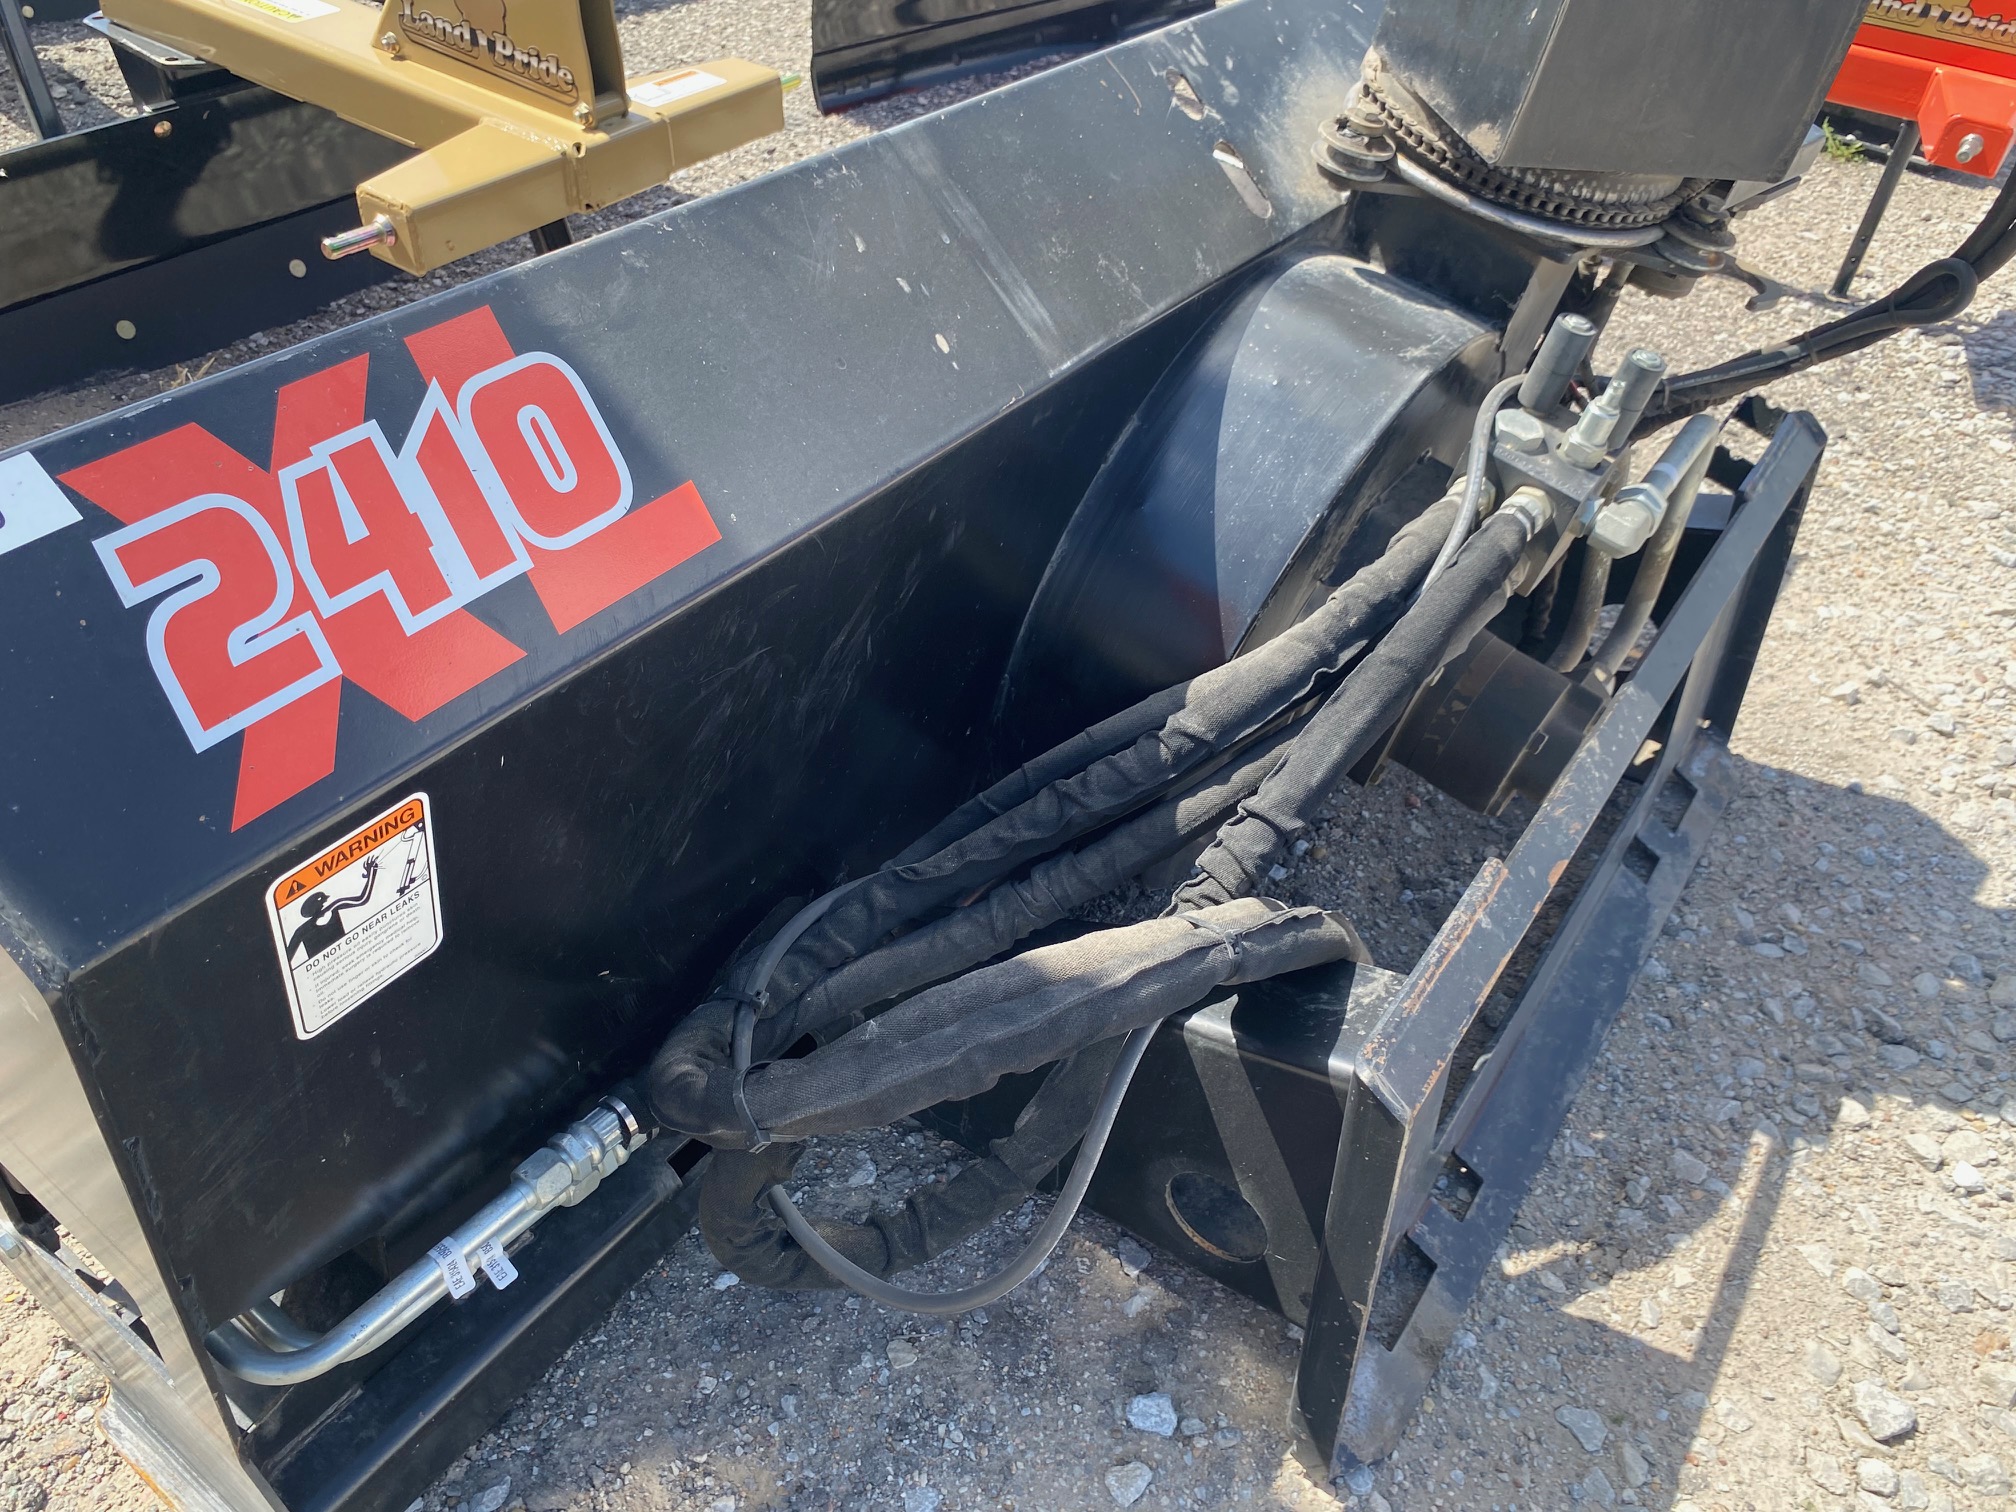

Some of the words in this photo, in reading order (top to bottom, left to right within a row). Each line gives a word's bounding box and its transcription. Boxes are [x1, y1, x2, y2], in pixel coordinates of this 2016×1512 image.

[400, 0, 473, 52] Land
[492, 31, 575, 92] Pride
[1941, 5, 2016, 43] Prid
[91, 351, 635, 754] 2410
[313, 806, 416, 878] WARNING
[306, 959, 319, 972] DO
[323, 945, 342, 960] NOT
[345, 931, 359, 945] GO
[362, 914, 387, 934] NEAR
[390, 892, 419, 915] LEAKS
[451, 1275, 466, 1291] EAE
